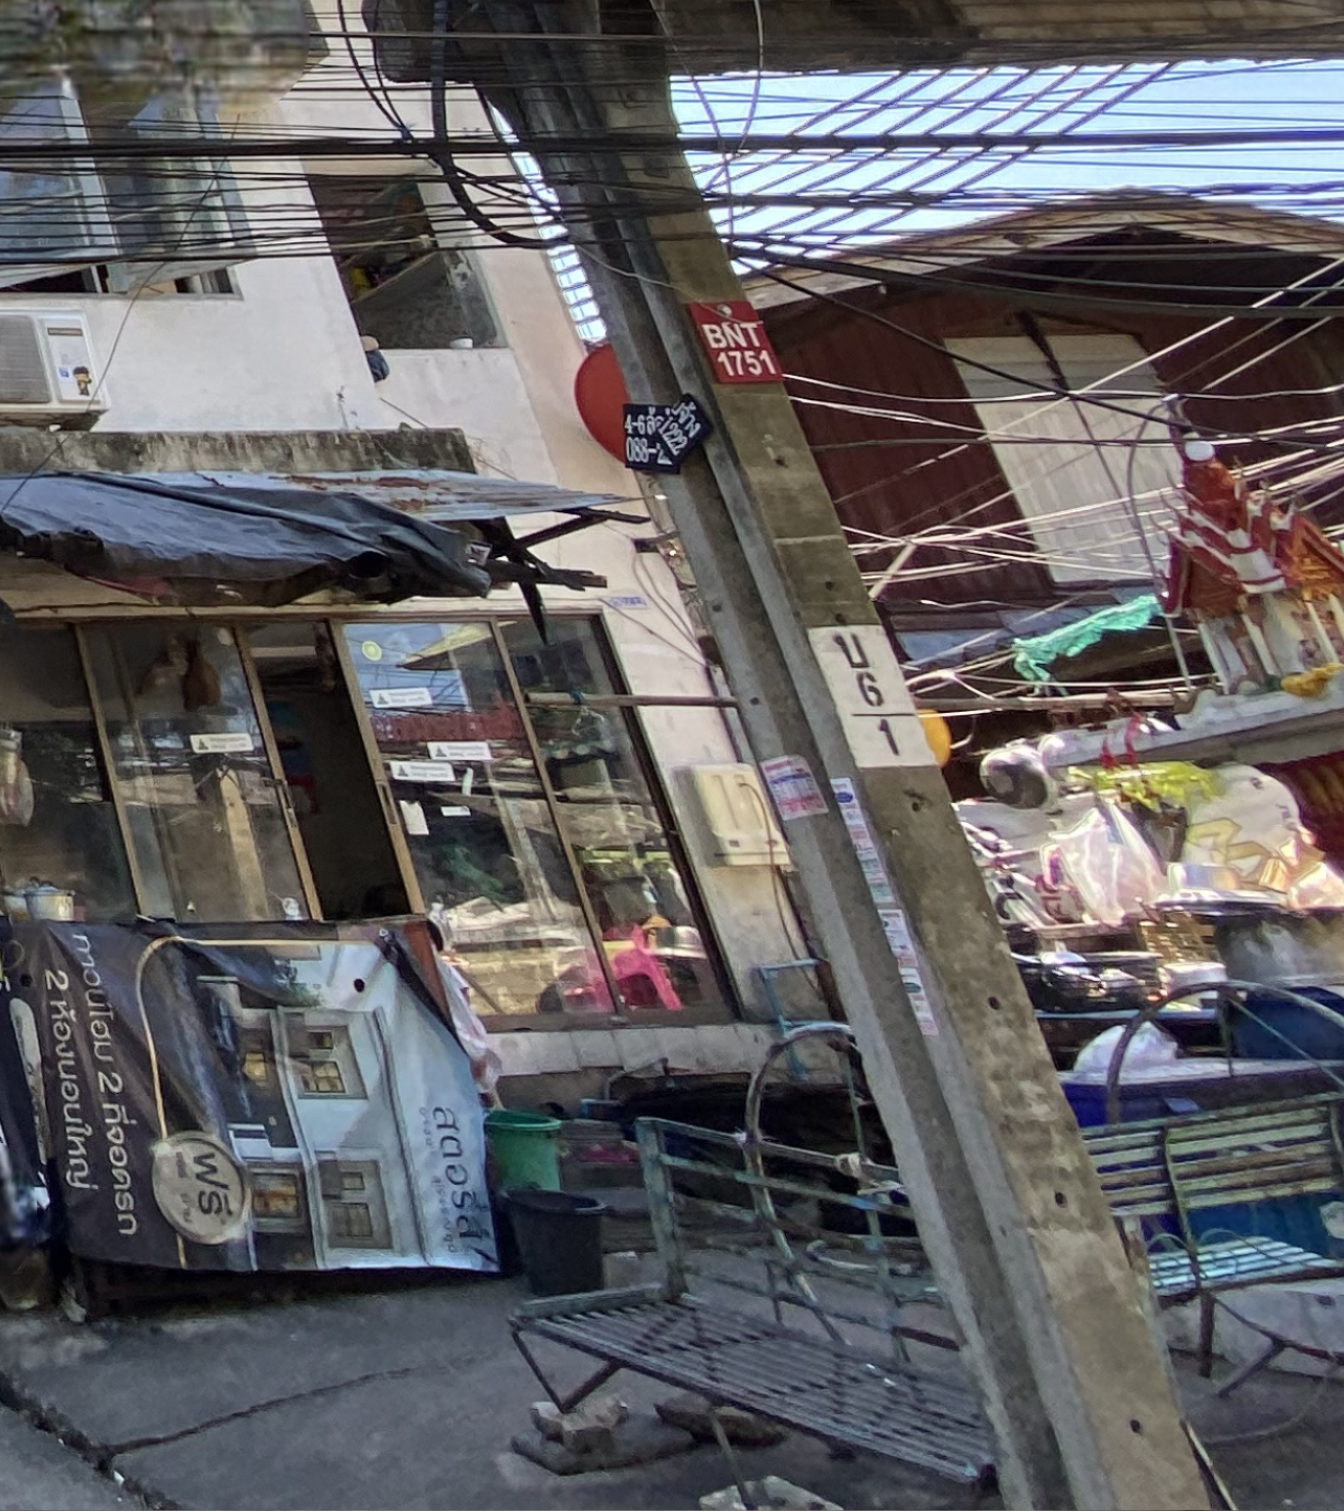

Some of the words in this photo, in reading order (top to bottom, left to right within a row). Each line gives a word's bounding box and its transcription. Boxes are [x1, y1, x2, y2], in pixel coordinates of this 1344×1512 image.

[702, 321, 761, 349] BNT
[717, 349, 777, 377] 1751
[856, 671, 884, 707] 6
[878, 718, 900, 756] 1
[44, 969, 69, 990] 2
[72, 933, 115, 1062] ทาวน์โฮม
[49, 999, 100, 1190] ห้องนอนใหญ่
[97, 1071, 123, 1093] 2
[102, 1101, 138, 1236] ที่จอดรถ
[193, 1152, 234, 1216] ฟรี
